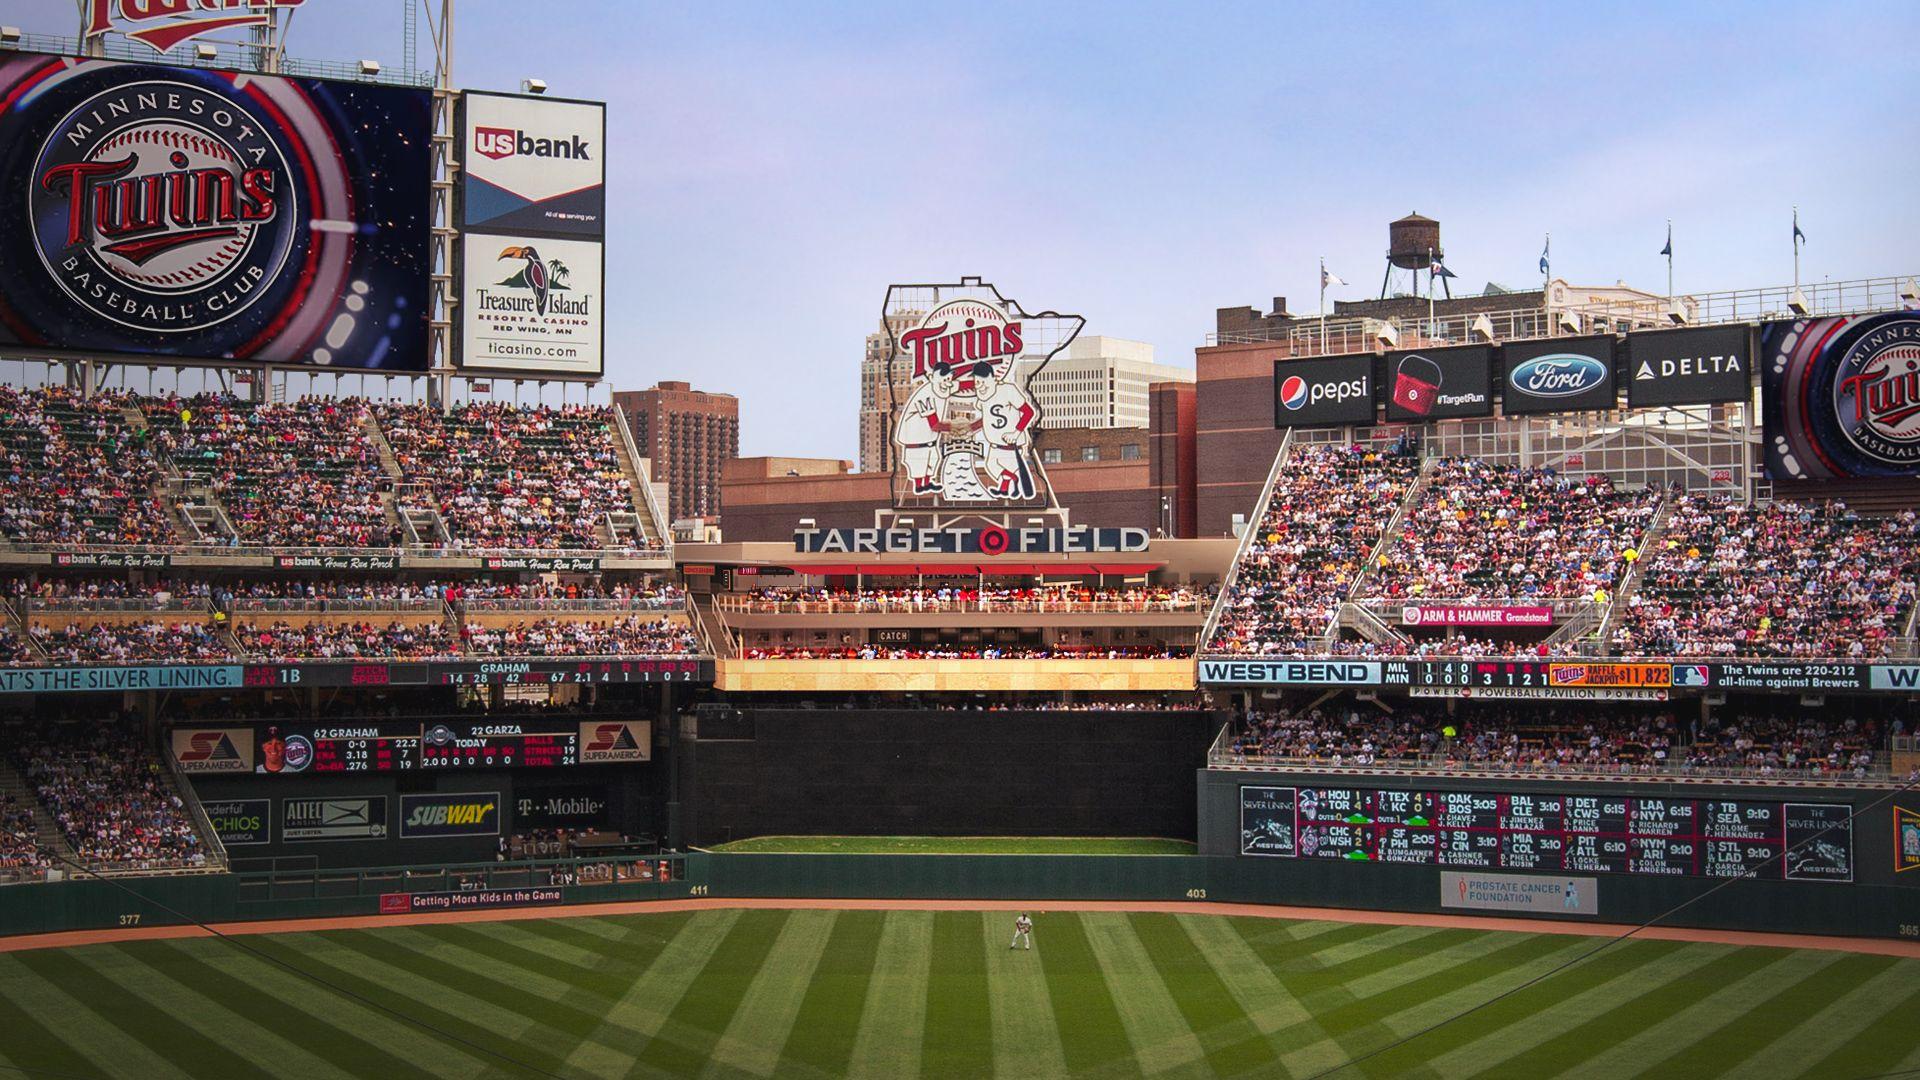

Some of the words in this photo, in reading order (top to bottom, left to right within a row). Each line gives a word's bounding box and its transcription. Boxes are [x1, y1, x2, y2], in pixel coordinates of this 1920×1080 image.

[67, 93, 266, 164] MINNESOTA
[42, 152, 276, 250] Twins
[62, 257, 194, 320] BASEBALL
[207, 265, 264, 311] CLUB
[477, 289, 534, 312] Treasure
[549, 293, 588, 315] Island
[478, 314, 524, 322] RESORT
[543, 318, 588, 326] CASINO
[517, 327, 551, 335] WING,
[489, 343, 577, 357] ticasino.com
[900, 318, 1024, 378] Twins
[1662, 355, 1740, 377] DELTA
[1529, 362, 1587, 391] Ford
[1311, 376, 1367, 403] pepsi
[1438, 393, 1484, 406] #TargetRun
[795, 528, 971, 552] TARGET
[1020, 528, 1150, 552] FIELD
[98, 555, 122, 566] Home
[124, 555, 141, 566] Run
[324, 557, 348, 568] Home
[350, 558, 368, 568] Run
[528, 558, 551, 570] Home
[553, 559, 570, 570] Run
[1422, 610, 1445, 621] ARM
[1447, 610, 1455, 622] &
[1458, 610, 1502, 622] HAMMER
[1506, 612, 1549, 623] Grandstand
[880, 631, 907, 640] CATCH
[481, 663, 530, 673] GRAHAM
[1204, 663, 1285, 681] WEST
[1288, 662, 1368, 681] BEND
[1388, 663, 1408, 672] MIL
[1722, 665, 1743, 675] The
[1746, 665, 1779, 675] Twins
[1782, 667, 1801, 675] are
[1805, 666, 1855, 676] 220-212
[40, 670, 81, 690] THE
[88, 669, 151, 689] SILVER
[158, 668, 232, 688] LINING.
[351, 675, 389, 684] SPEED
[449, 673, 463, 683] 14
[473, 673, 488, 683] 28
[506, 673, 519, 682] 42
[551, 673, 565, 682] 67
[575, 672, 591, 682] 2.1
[1385, 674, 1409, 683] MIN
[1552, 666, 1585, 683] Twins
[1585, 675, 1619, 684] JACKPOT
[1588, 665, 1616, 674] RAFFLE
[1619, 667, 1670, 687] $11,823
[1719, 676, 1763, 687] all-time
[1766, 676, 1809, 689] against
[1812, 677, 1860, 688] Brewers
[1478, 688, 1541, 698] POWERBALL
[1545, 689, 1596, 698] PAVILION
[314, 729, 327, 738] 62
[329, 728, 379, 737] GRAHAM
[471, 727, 483, 735] 22
[485, 726, 522, 735] GARZA
[396, 739, 417, 748] 22.2
[455, 739, 487, 748] TODAY
[346, 751, 368, 760] 3.18
[584, 750, 643, 760] SUPERAMERICA
[346, 761, 368, 770] .276
[400, 760, 411, 769] 19
[525, 757, 553, 766] TOTAL
[562, 756, 575, 765] 24
[1328, 789, 1350, 800] HOU
[1388, 793, 1410, 802] TEX
[1328, 800, 1350, 810] TOR
[1448, 794, 1472, 804] OAK
[1473, 800, 1497, 809] 3:05
[1511, 796, 1534, 806] BAL
[1539, 802, 1560, 812] 3:10
[1576, 798, 1598, 808] DET
[1603, 804, 1625, 814] 6:15
[287, 802, 322, 820] ALTEC
[1391, 803, 1407, 812] KC
[1449, 804, 1472, 814] BOS
[1512, 806, 1533, 816] CLE
[1640, 800, 1664, 810] LAA
[1670, 806, 1692, 817] 6:15
[1721, 803, 1737, 813] TB
[1746, 809, 1770, 819] 9:10
[1810, 809, 1825, 817] THE
[406, 802, 494, 826] SUBWAY
[1574, 808, 1600, 819] CWS
[1717, 814, 1741, 824] SEA
[1787, 819, 1815, 829] SILVER
[1329, 826, 1350, 836] CHC
[1393, 829, 1406, 838] SF
[1412, 835, 1436, 844] 2:05
[1453, 831, 1468, 841] SD
[221, 833, 254, 841] AMERICA
[1329, 837, 1352, 846] WSH
[1513, 834, 1533, 844] MIA
[1540, 839, 1561, 849] 3:10
[1391, 839, 1408, 848] PHI
[1452, 841, 1469, 851] CIN
[1513, 844, 1534, 854] COL
[1578, 836, 1597, 846] PIT
[1604, 842, 1626, 852] 6:10
[1719, 842, 1741, 852] STL
[1577, 846, 1599, 857] ATL
[1643, 849, 1664, 859] ARI
[1670, 845, 1693, 855] 9:10
[1718, 853, 1742, 863] LAD
[690, 885, 708, 895] 411
[1469, 881, 1518, 892] PROSTATE
[1521, 883, 1561, 894] CANCER
[413, 896, 450, 907] Getting
[452, 895, 477, 904] More
[479, 892, 501, 902] Kids
[515, 891, 530, 900] the
[532, 890, 560, 900] Game
[1186, 888, 1206, 899] 403
[1469, 892, 1532, 903] FOUNDATION
[120, 914, 140, 925] 377
[1899, 924, 1919, 936] 365
